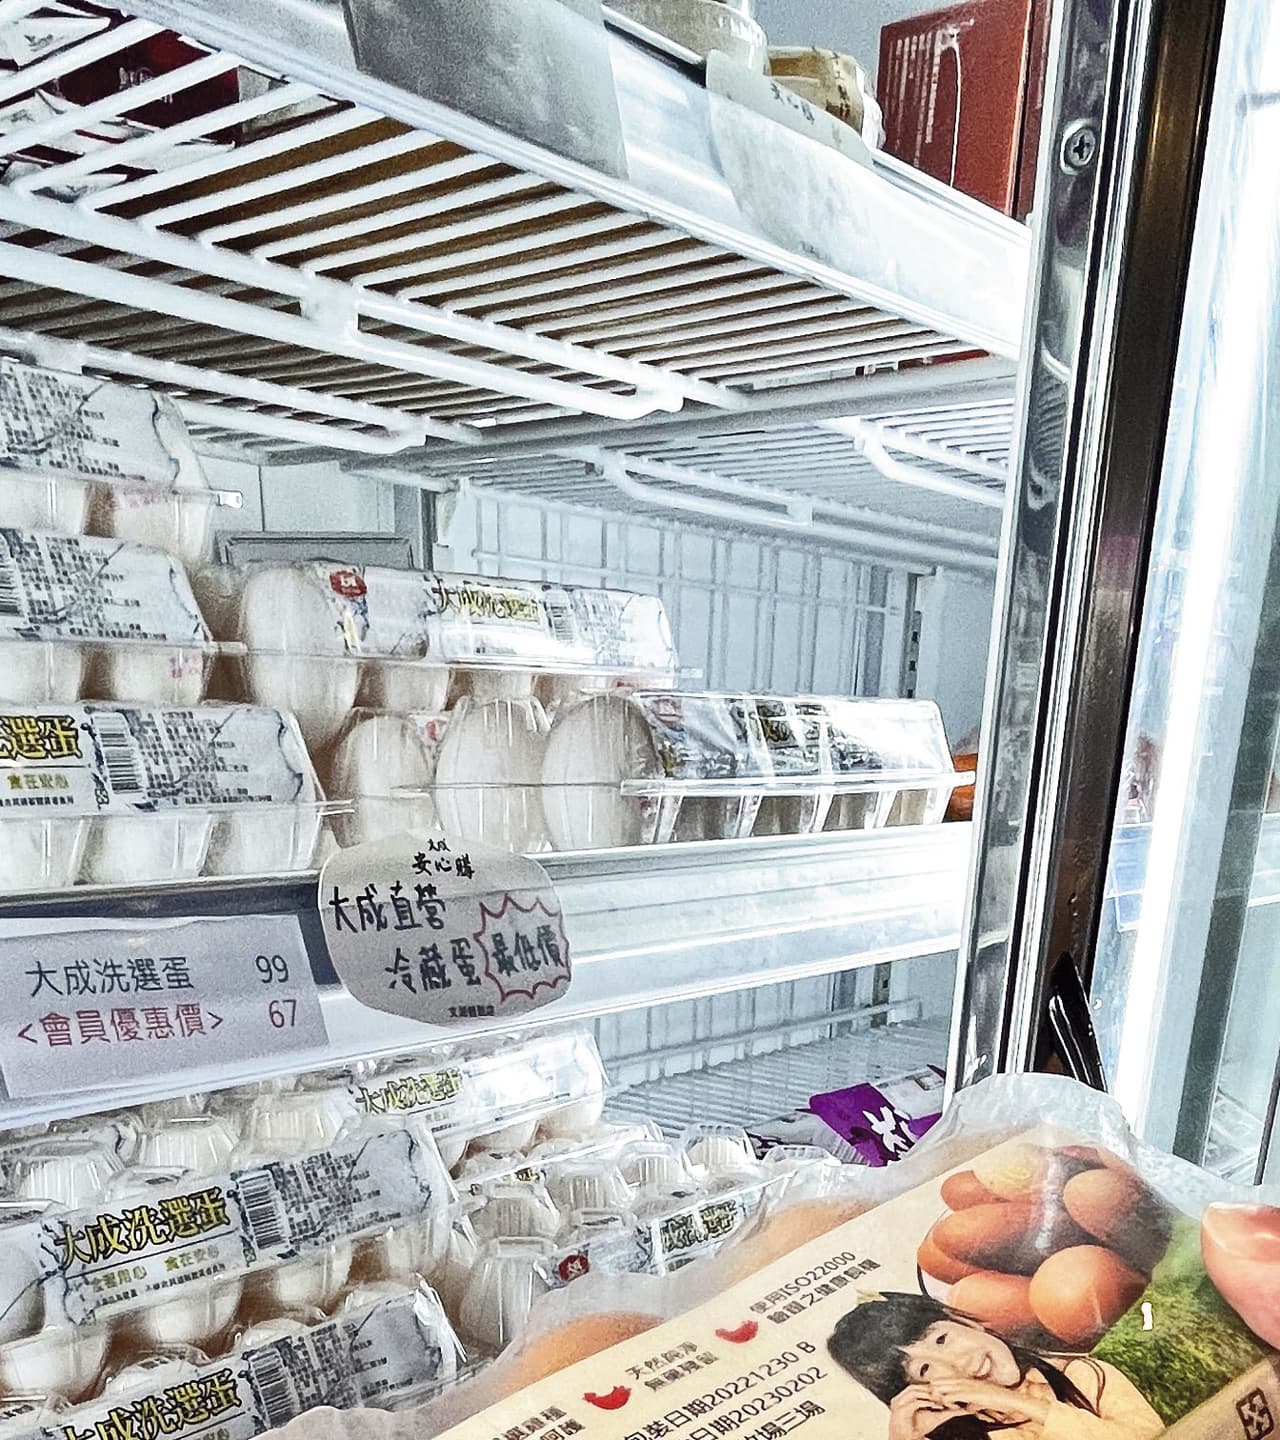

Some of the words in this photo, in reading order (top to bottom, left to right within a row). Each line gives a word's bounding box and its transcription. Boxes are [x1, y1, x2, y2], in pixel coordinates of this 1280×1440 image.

[412, 852, 475, 879] 安心購
[328, 880, 446, 933] 大成直營
[25, 955, 194, 998] 大成洗選蛋
[255, 954, 289, 984] 99
[385, 937, 481, 994] 冷藏蛋
[491, 924, 565, 977] 最低價
[16, 1002, 224, 1048] <會員優惠價>
[268, 1000, 296, 1029] 67
[54, 1185, 232, 1270] 大成洗選蛋
[750, 1250, 857, 1318] 使用ISO22000
[800, 1340, 817, 1357] B
